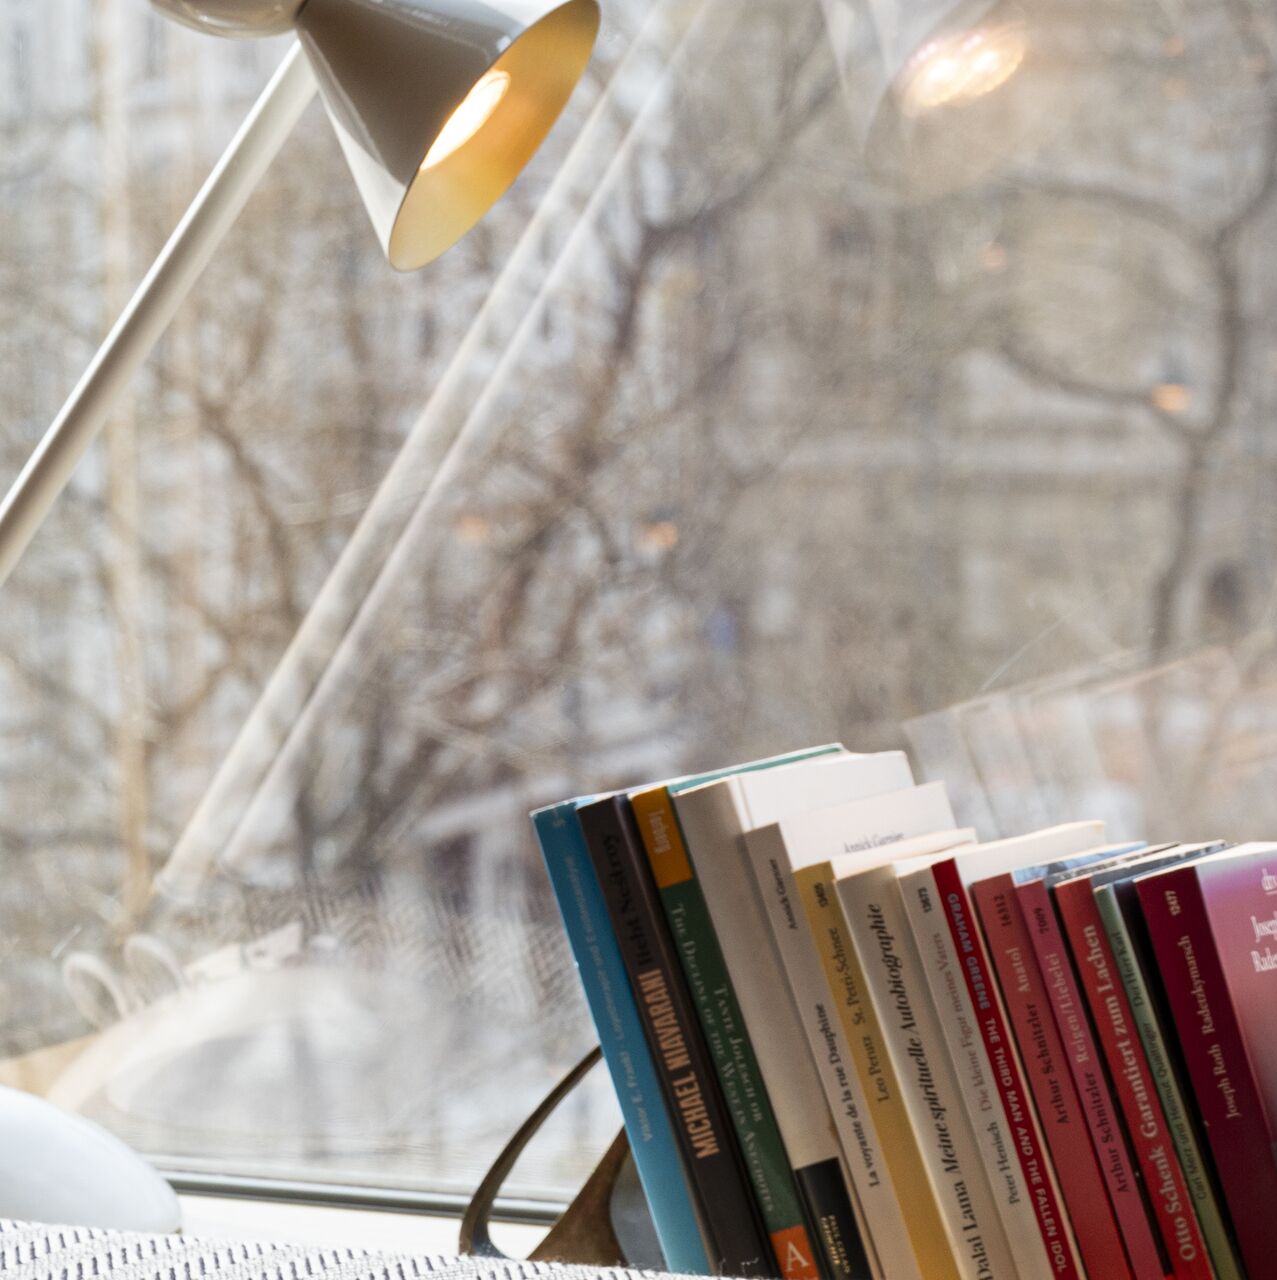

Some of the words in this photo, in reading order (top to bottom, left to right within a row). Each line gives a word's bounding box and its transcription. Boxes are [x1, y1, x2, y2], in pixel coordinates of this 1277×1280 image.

[603, 834, 634, 913] Nestroy
[626, 918, 651, 966] liebt
[933, 933, 949, 971] Vaters
[1084, 926, 1114, 993] Lachen
[829, 928, 860, 1007] Petri-Schnee
[867, 904, 916, 1032] Autobiographie
[1005, 947, 1029, 992] Anatol
[1177, 935, 1216, 1034] Radetzkymarsch
[945, 971, 963, 1012] meines
[1044, 953, 1089, 1063] Reigen/Liebelei
[1131, 987, 1144, 1007] Der
[637, 969, 691, 1071] NIAVARANI
[816, 1004, 841, 1065] Dauphine
[853, 1007, 866, 1025] St.
[956, 1016, 973, 1048] Figur
[1106, 996, 1127, 1035] zum
[863, 1036, 882, 1076] Perutz
[1026, 1003, 1053, 1074] Schnitzler
[1143, 1023, 1168, 1078] Qualtinger
[1208, 1044, 1227, 1075] Roth
[836, 1067, 848, 1087] rue
[877, 1078, 890, 1103] Leo
[907, 1038, 947, 1121] spirituelle
[948, 894, 973, 952] GRAHAM
[967, 957, 991, 1009] GREENE
[985, 1018, 1001, 1045] THE
[994, 1047, 1013, 1086] THIRD
[1007, 1090, 1023, 1122] MAN
[1016, 1127, 1033, 1156] AND
[1027, 1159, 1043, 1186] THE
[1035, 1188, 1057, 1237] FALLEN
[1050, 1240, 1067, 1273] IDOL
[968, 1051, 985, 1088] kleine
[1117, 1039, 1158, 1138] Garantiert
[672, 1071, 719, 1159] MICHAEL
[841, 1090, 853, 1103] la
[846, 1104, 858, 1118] de
[980, 1090, 992, 1112] Die
[1048, 1079, 1069, 1123] Arthur
[1084, 1072, 1113, 1143] Schnitzler
[1161, 1081, 1181, 1121] Helmut
[1217, 1078, 1242, 1119] Joseph
[853, 1122, 873, 1169] voyante
[935, 1124, 959, 1172] Meine
[986, 1122, 1011, 1172] Henisch
[1174, 1123, 1189, 1144] und
[868, 1171, 880, 1187] La
[1108, 1148, 1129, 1192] Arthur
[1148, 1145, 1182, 1213] Schenk
[1183, 1148, 1197, 1174] Merz
[955, 1181, 978, 1232] Lama
[1004, 1175, 1021, 1204] Peter
[1191, 1177, 1207, 1200] Carl
[785, 1241, 809, 1272] A
[1175, 1217, 1196, 1261] Otto
